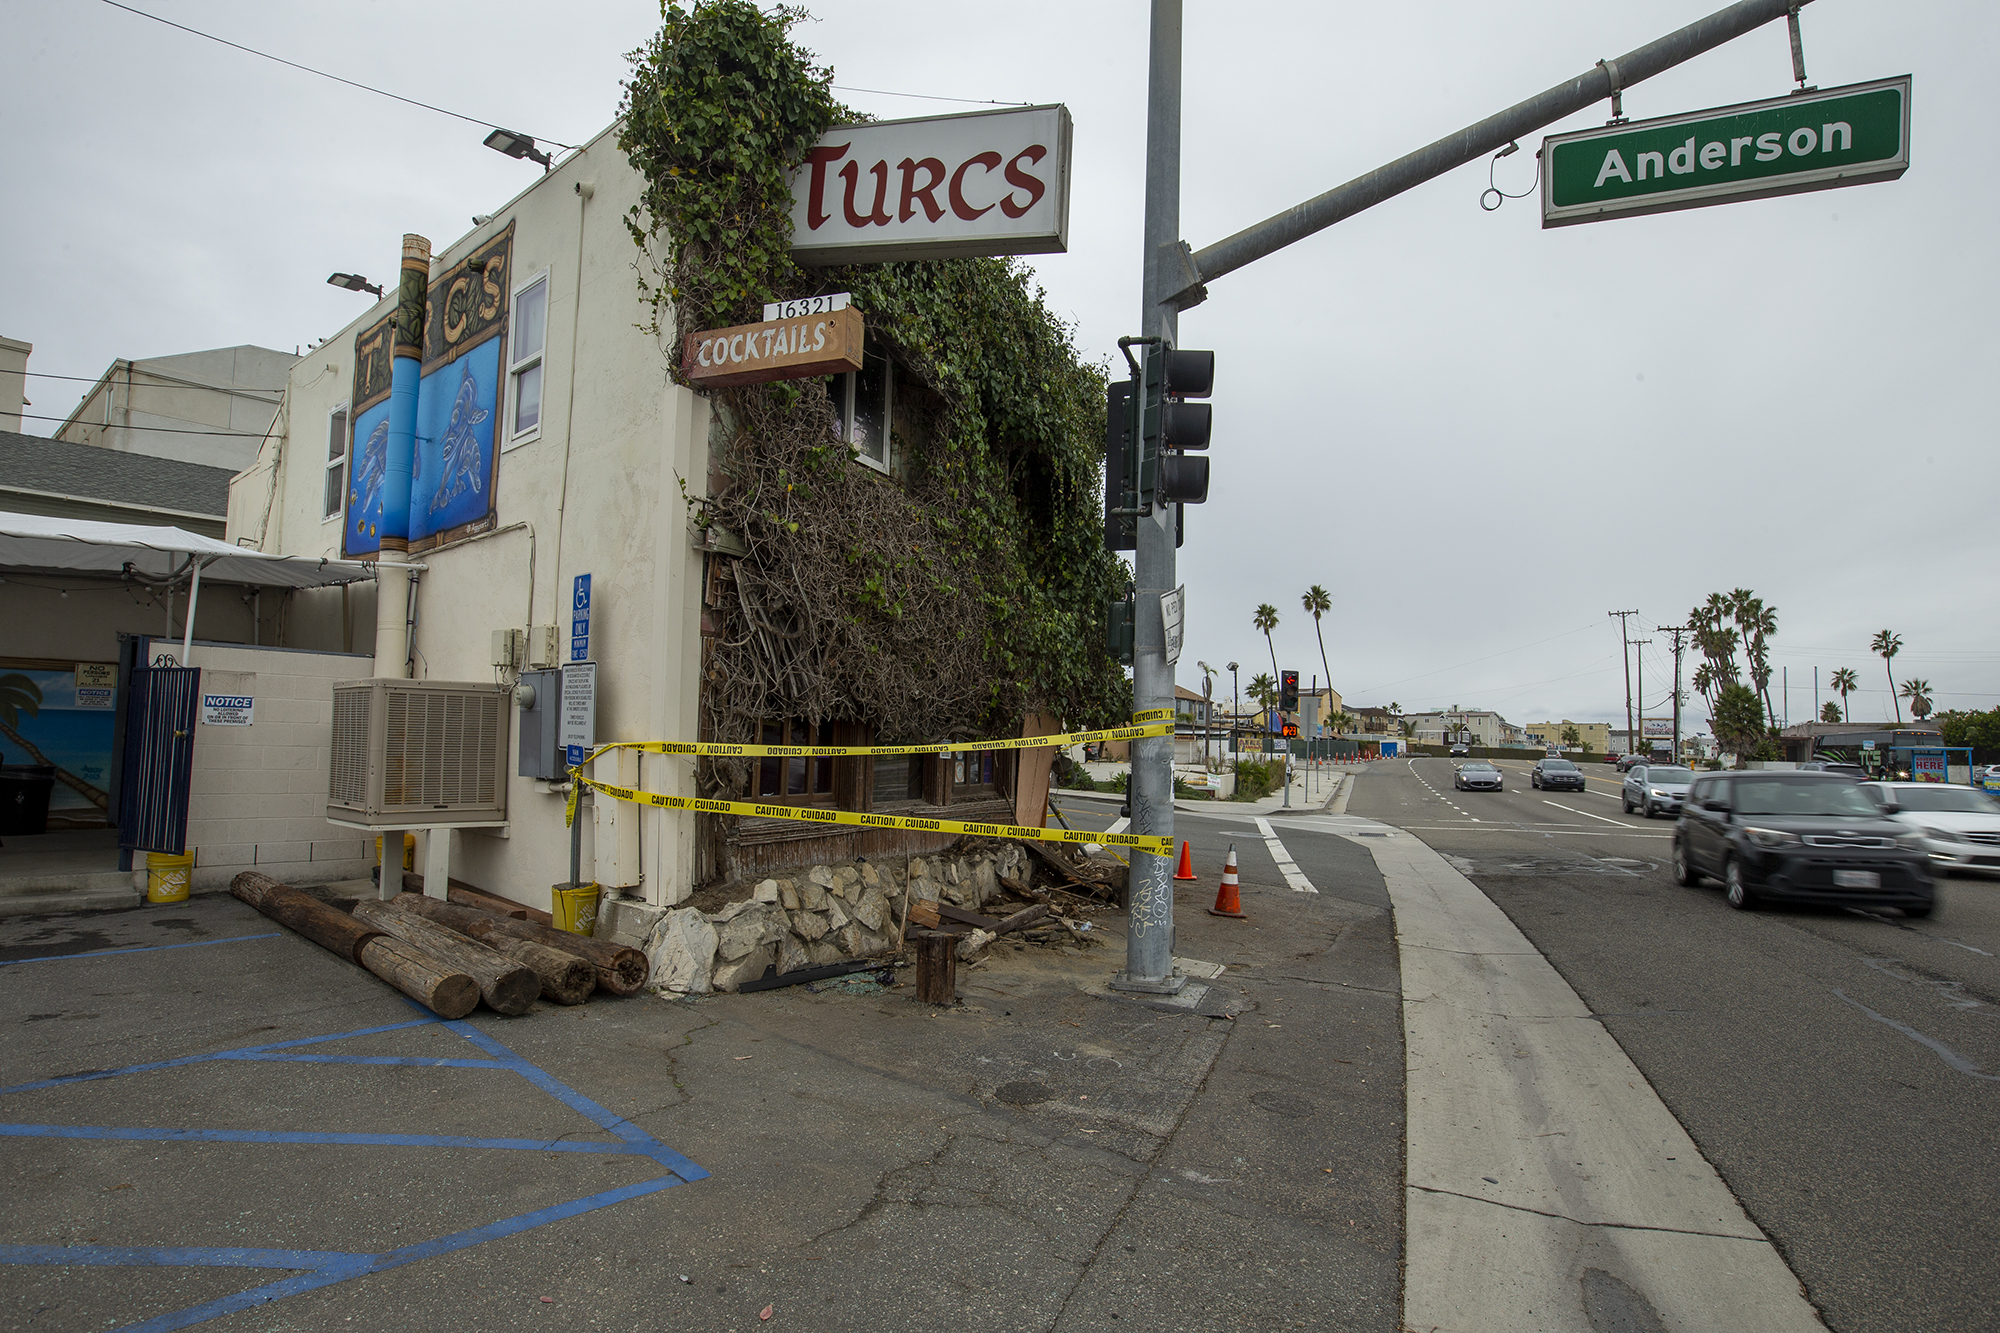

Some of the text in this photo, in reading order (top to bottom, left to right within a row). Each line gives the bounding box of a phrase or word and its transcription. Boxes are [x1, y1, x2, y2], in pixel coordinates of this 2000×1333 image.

[1593, 121, 1852, 188] Anderson
[789, 141, 1047, 230] TURCS
[776, 296, 834, 319] 16321
[698, 321, 826, 367] COCKTAILS
[573, 608, 589, 621] PARKING
[575, 622, 586, 635] ONLY
[206, 697, 251, 707] NOTICE
[1135, 711, 1163, 722] CUIDADO
[1070, 731, 1103, 742] CUIDADO
[1112, 727, 1144, 739] CAUTION
[972, 741, 1005, 749] CUIDADO
[1015, 737, 1048, 747] CAUTION
[662, 743, 697, 753] CUIDADO
[707, 745, 743, 754] CAUTION
[767, 747, 802, 755] CUIDADO
[812, 747, 847, 755] CAUTION
[914, 745, 949, 753] CAUTION
[1916, 761, 1943, 770] HERE
[609, 788, 634, 799] CUIDADO
[651, 795, 685, 807] CAUTION
[694, 802, 731, 812] CUIDADO
[755, 806, 791, 817] CAUTION
[801, 810, 836, 821] CUIDADO
[860, 815, 895, 826] CAUTION
[905, 820, 940, 830] CUIDADO
[963, 824, 998, 834] CAUTION
[1007, 827, 1041, 838] CUIDADO
[1063, 832, 1097, 842] CAUTION
[1106, 835, 1139, 845] CUIDADO
